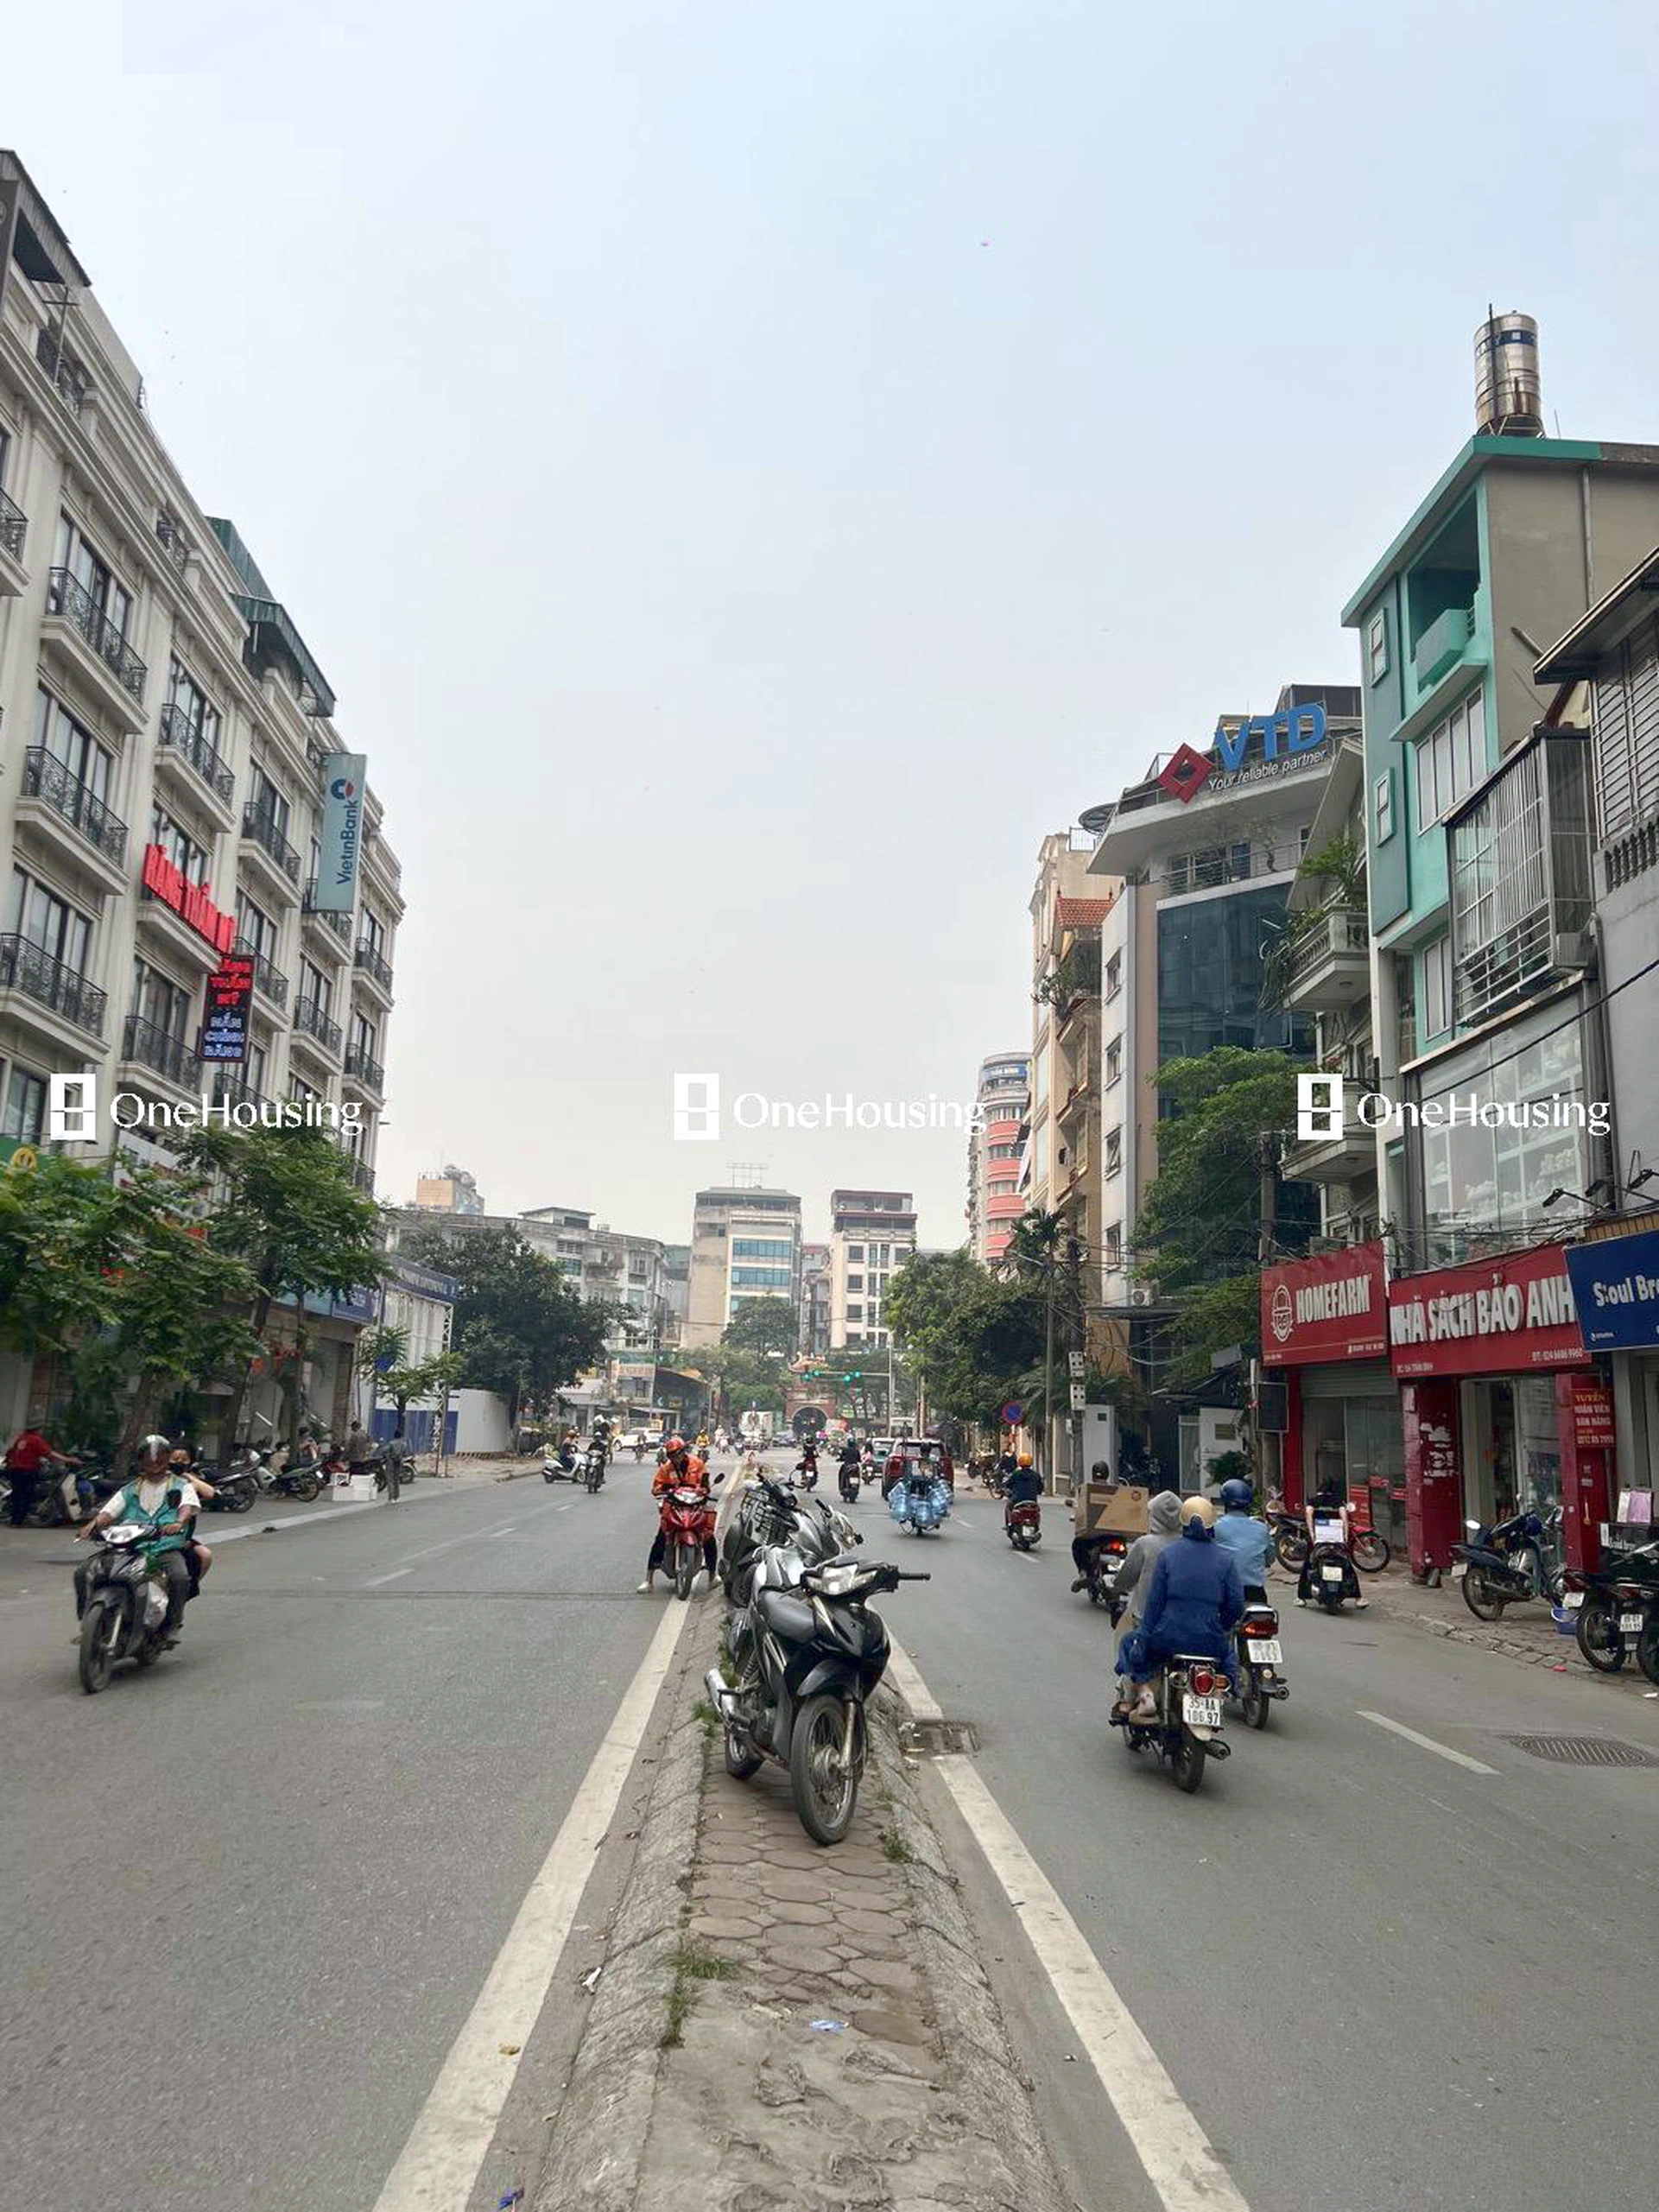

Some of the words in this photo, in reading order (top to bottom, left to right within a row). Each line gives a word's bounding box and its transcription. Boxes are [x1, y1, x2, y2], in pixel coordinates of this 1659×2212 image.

[1208, 773, 1236, 792] Your
[1237, 761, 1279, 783] reliable
[1282, 749, 1328, 775] partner
[1214, 702, 1327, 771] VTD
[335, 798, 358, 885] VietinBank
[1295, 1274, 1371, 1324] HOMEFARM
[1390, 1296, 1425, 1347] NHÀ
[1428, 1290, 1477, 1341] SÁCH
[1476, 1273, 1523, 1334] BẢO
[1526, 1274, 1576, 1328] ANH
